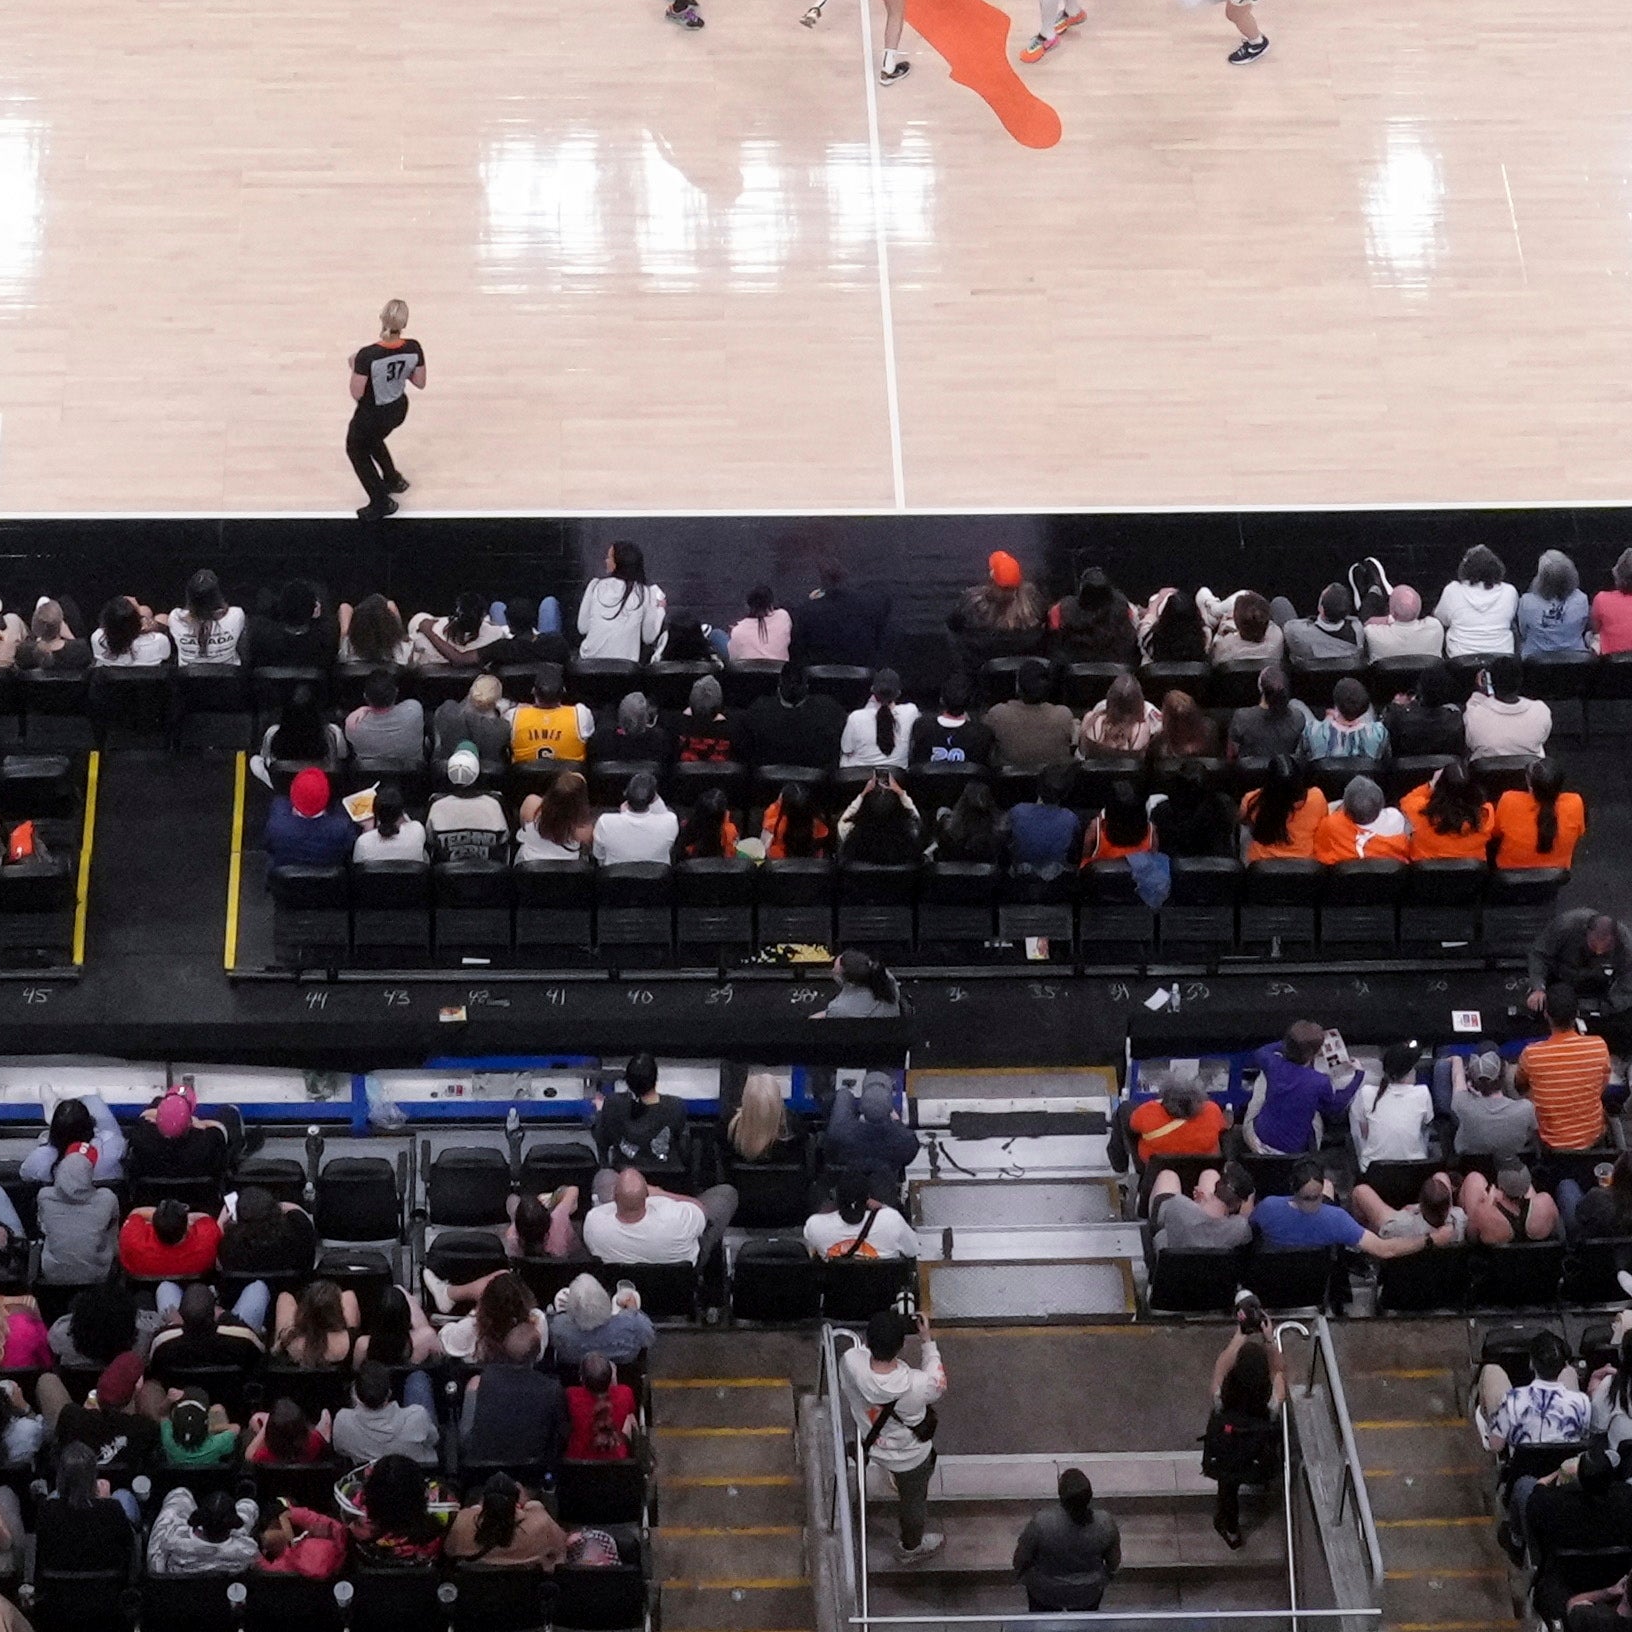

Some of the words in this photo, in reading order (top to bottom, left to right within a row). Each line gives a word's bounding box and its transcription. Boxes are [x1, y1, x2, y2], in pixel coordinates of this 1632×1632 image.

[386, 360, 406, 382] 37
[179, 634, 235, 646] CAADA
[528, 729, 563, 742] JAMES
[22, 988, 54, 1004] 45
[305, 991, 330, 1010] 44
[383, 989, 411, 1006] 43
[545, 988, 567, 1006] 41
[627, 989, 654, 1005] 40
[705, 982, 735, 1006] 39
